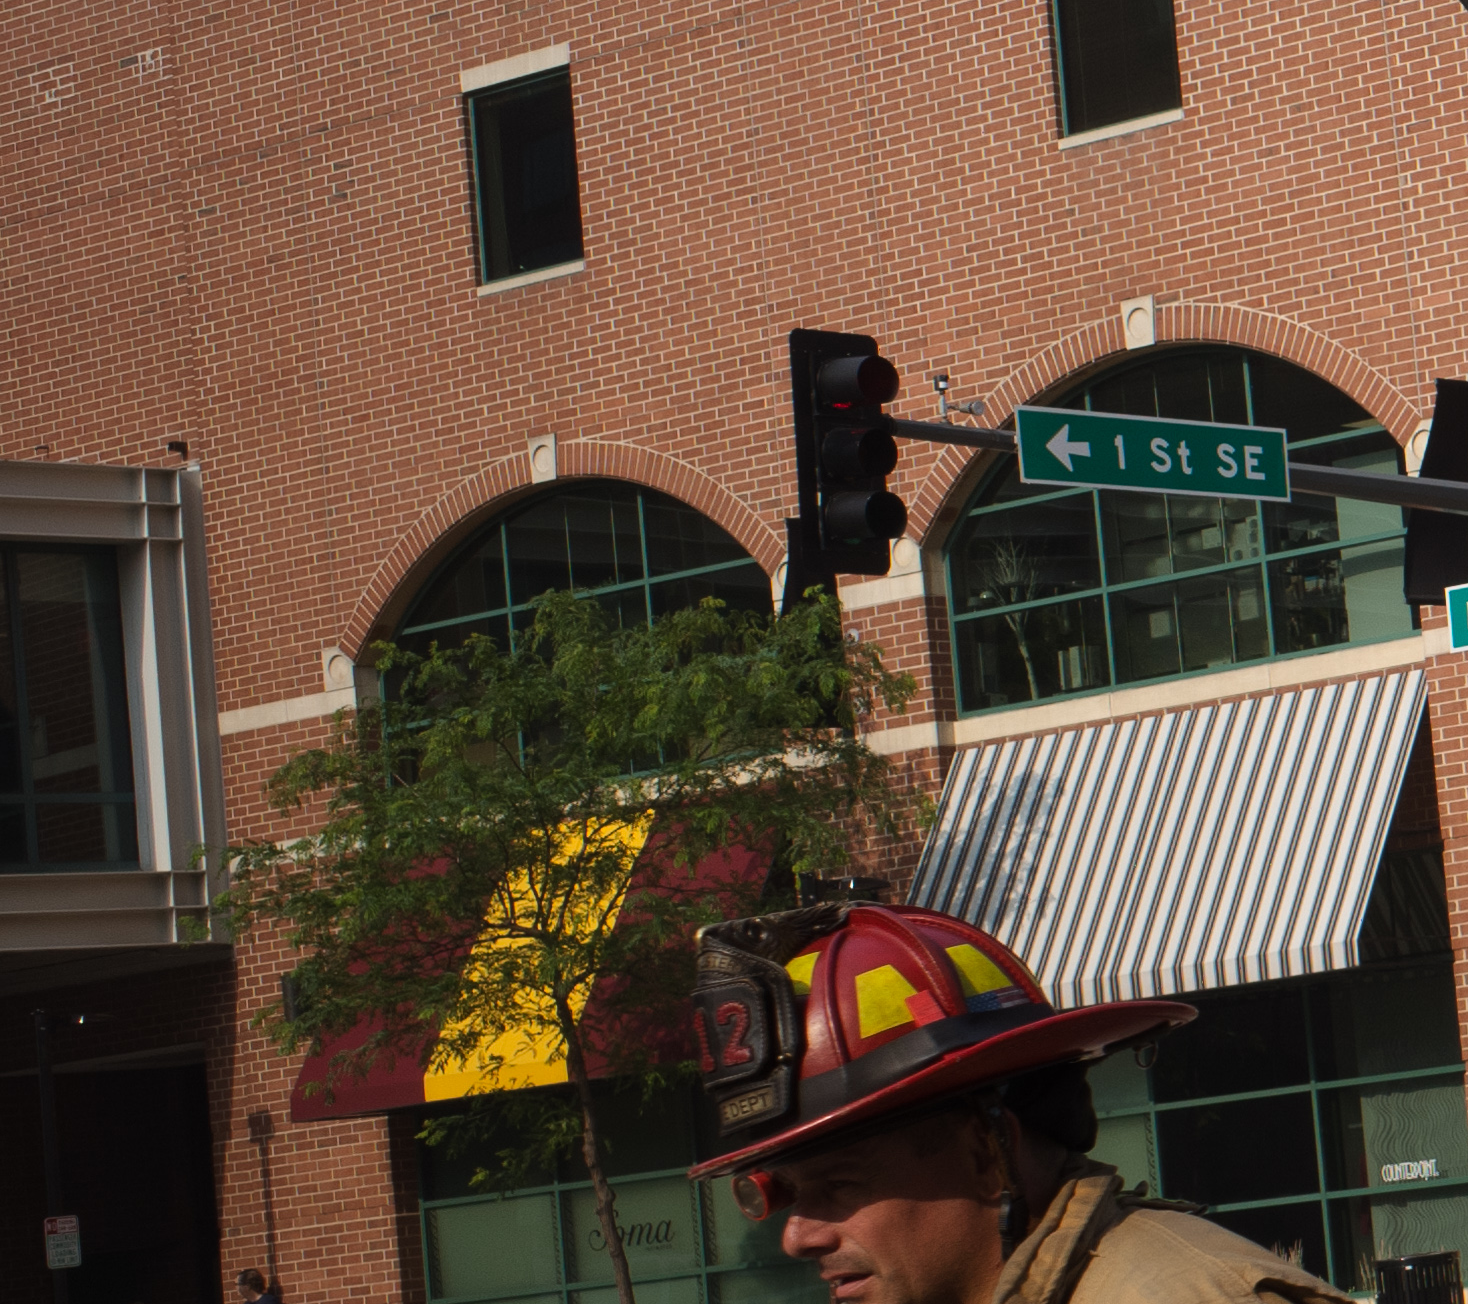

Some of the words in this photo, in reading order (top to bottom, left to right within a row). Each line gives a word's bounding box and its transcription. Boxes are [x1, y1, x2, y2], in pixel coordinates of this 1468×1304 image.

[1113, 434, 1126, 470] 1
[1150, 436, 1194, 477] St
[1217, 443, 1266, 481] SE
[729, 1092, 770, 1118] DEPT
